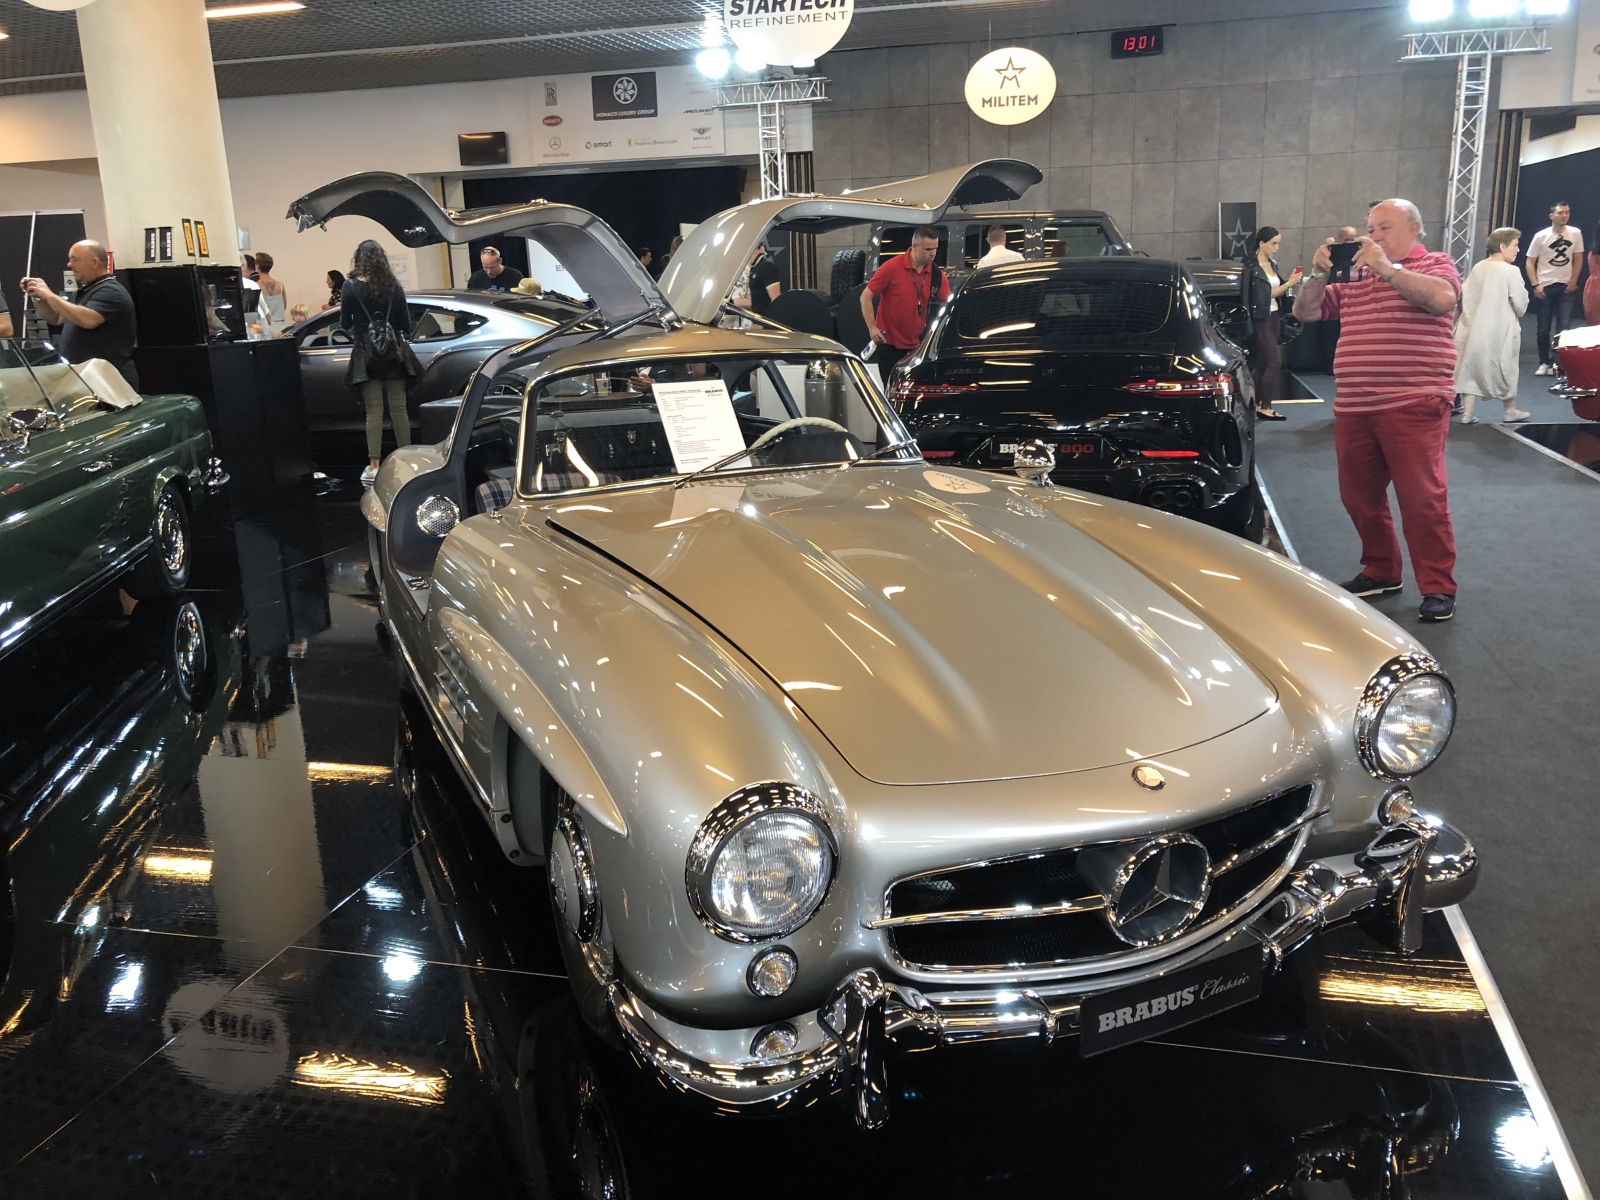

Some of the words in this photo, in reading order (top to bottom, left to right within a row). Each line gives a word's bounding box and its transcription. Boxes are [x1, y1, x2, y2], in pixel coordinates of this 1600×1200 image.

[730, 11, 848, 29] REFINEMENT
[981, 94, 1039, 108] MILITEM
[999, 443, 1056, 454] BRS
[1060, 443, 1095, 453] 800
[1098, 984, 1197, 1033] BRABUS
[1200, 972, 1250, 1001] Classic
